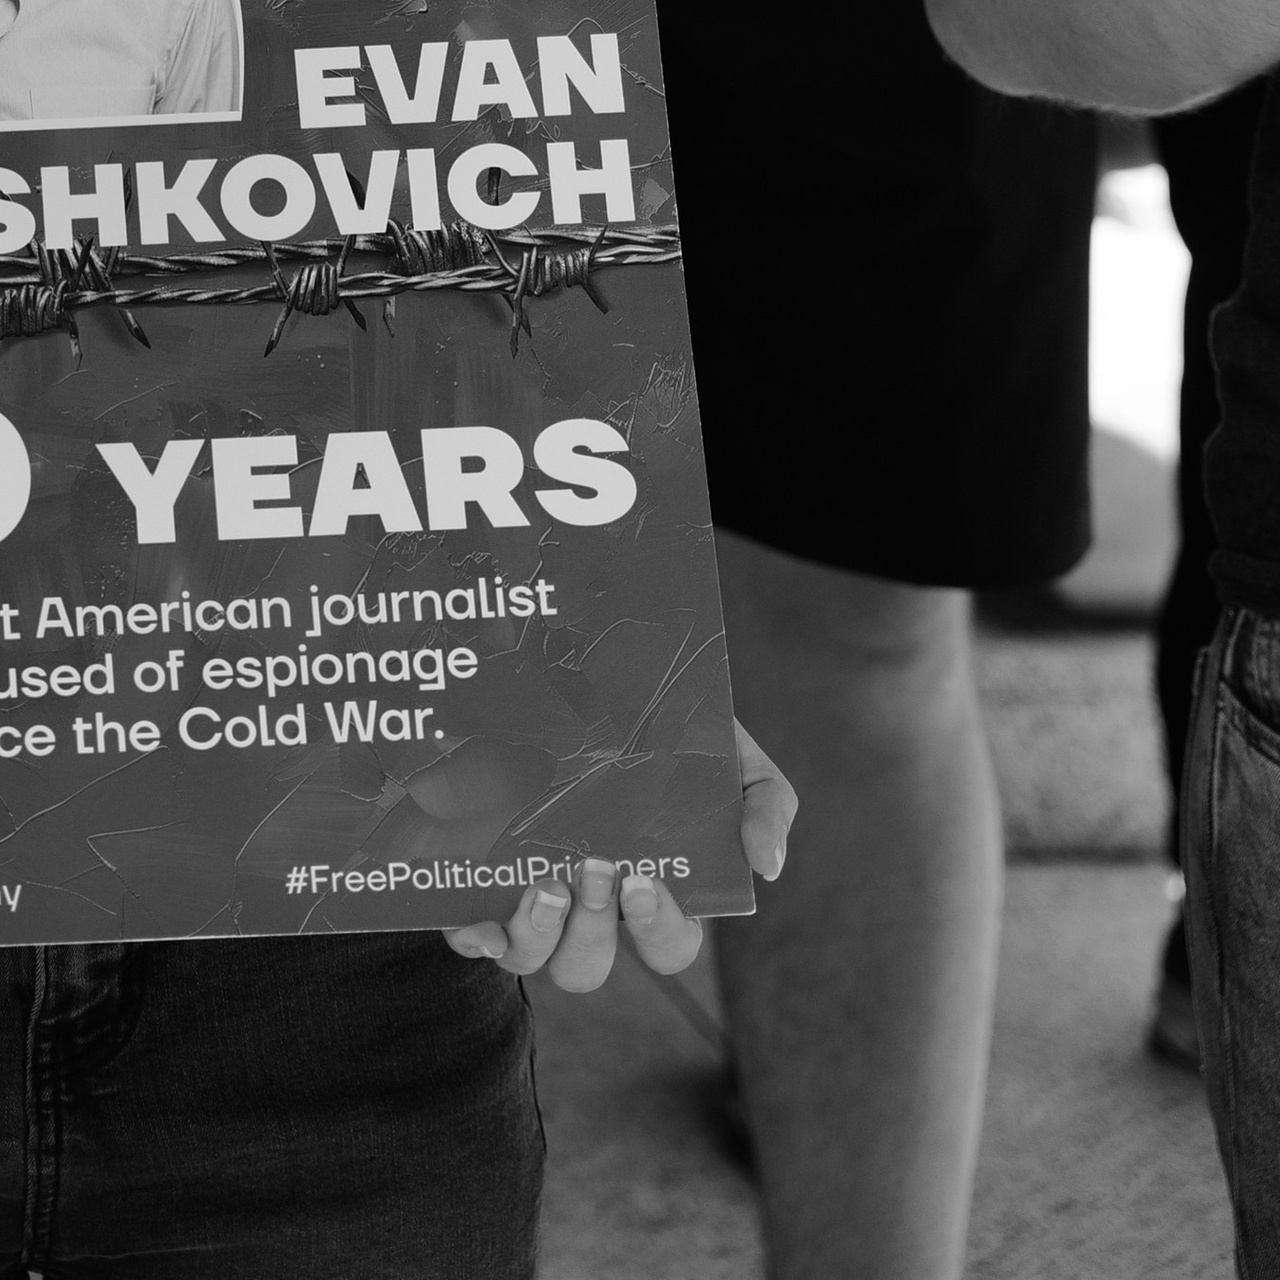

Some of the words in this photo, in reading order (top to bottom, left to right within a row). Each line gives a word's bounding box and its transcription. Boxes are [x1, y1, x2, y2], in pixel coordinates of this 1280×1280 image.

[293, 33, 626, 130] EVAN
[95, 417, 638, 545] YEARS
[36, 590, 292, 639] American
[305, 576, 558, 637] journalist
[133, 649, 185, 693] of
[202, 644, 478, 697] espionage
[72, 712, 161, 754] the
[178, 703, 308, 750] Cold
[324, 700, 445, 744] War.
[285, 855, 691, 896] #FreePoliticalPriners
